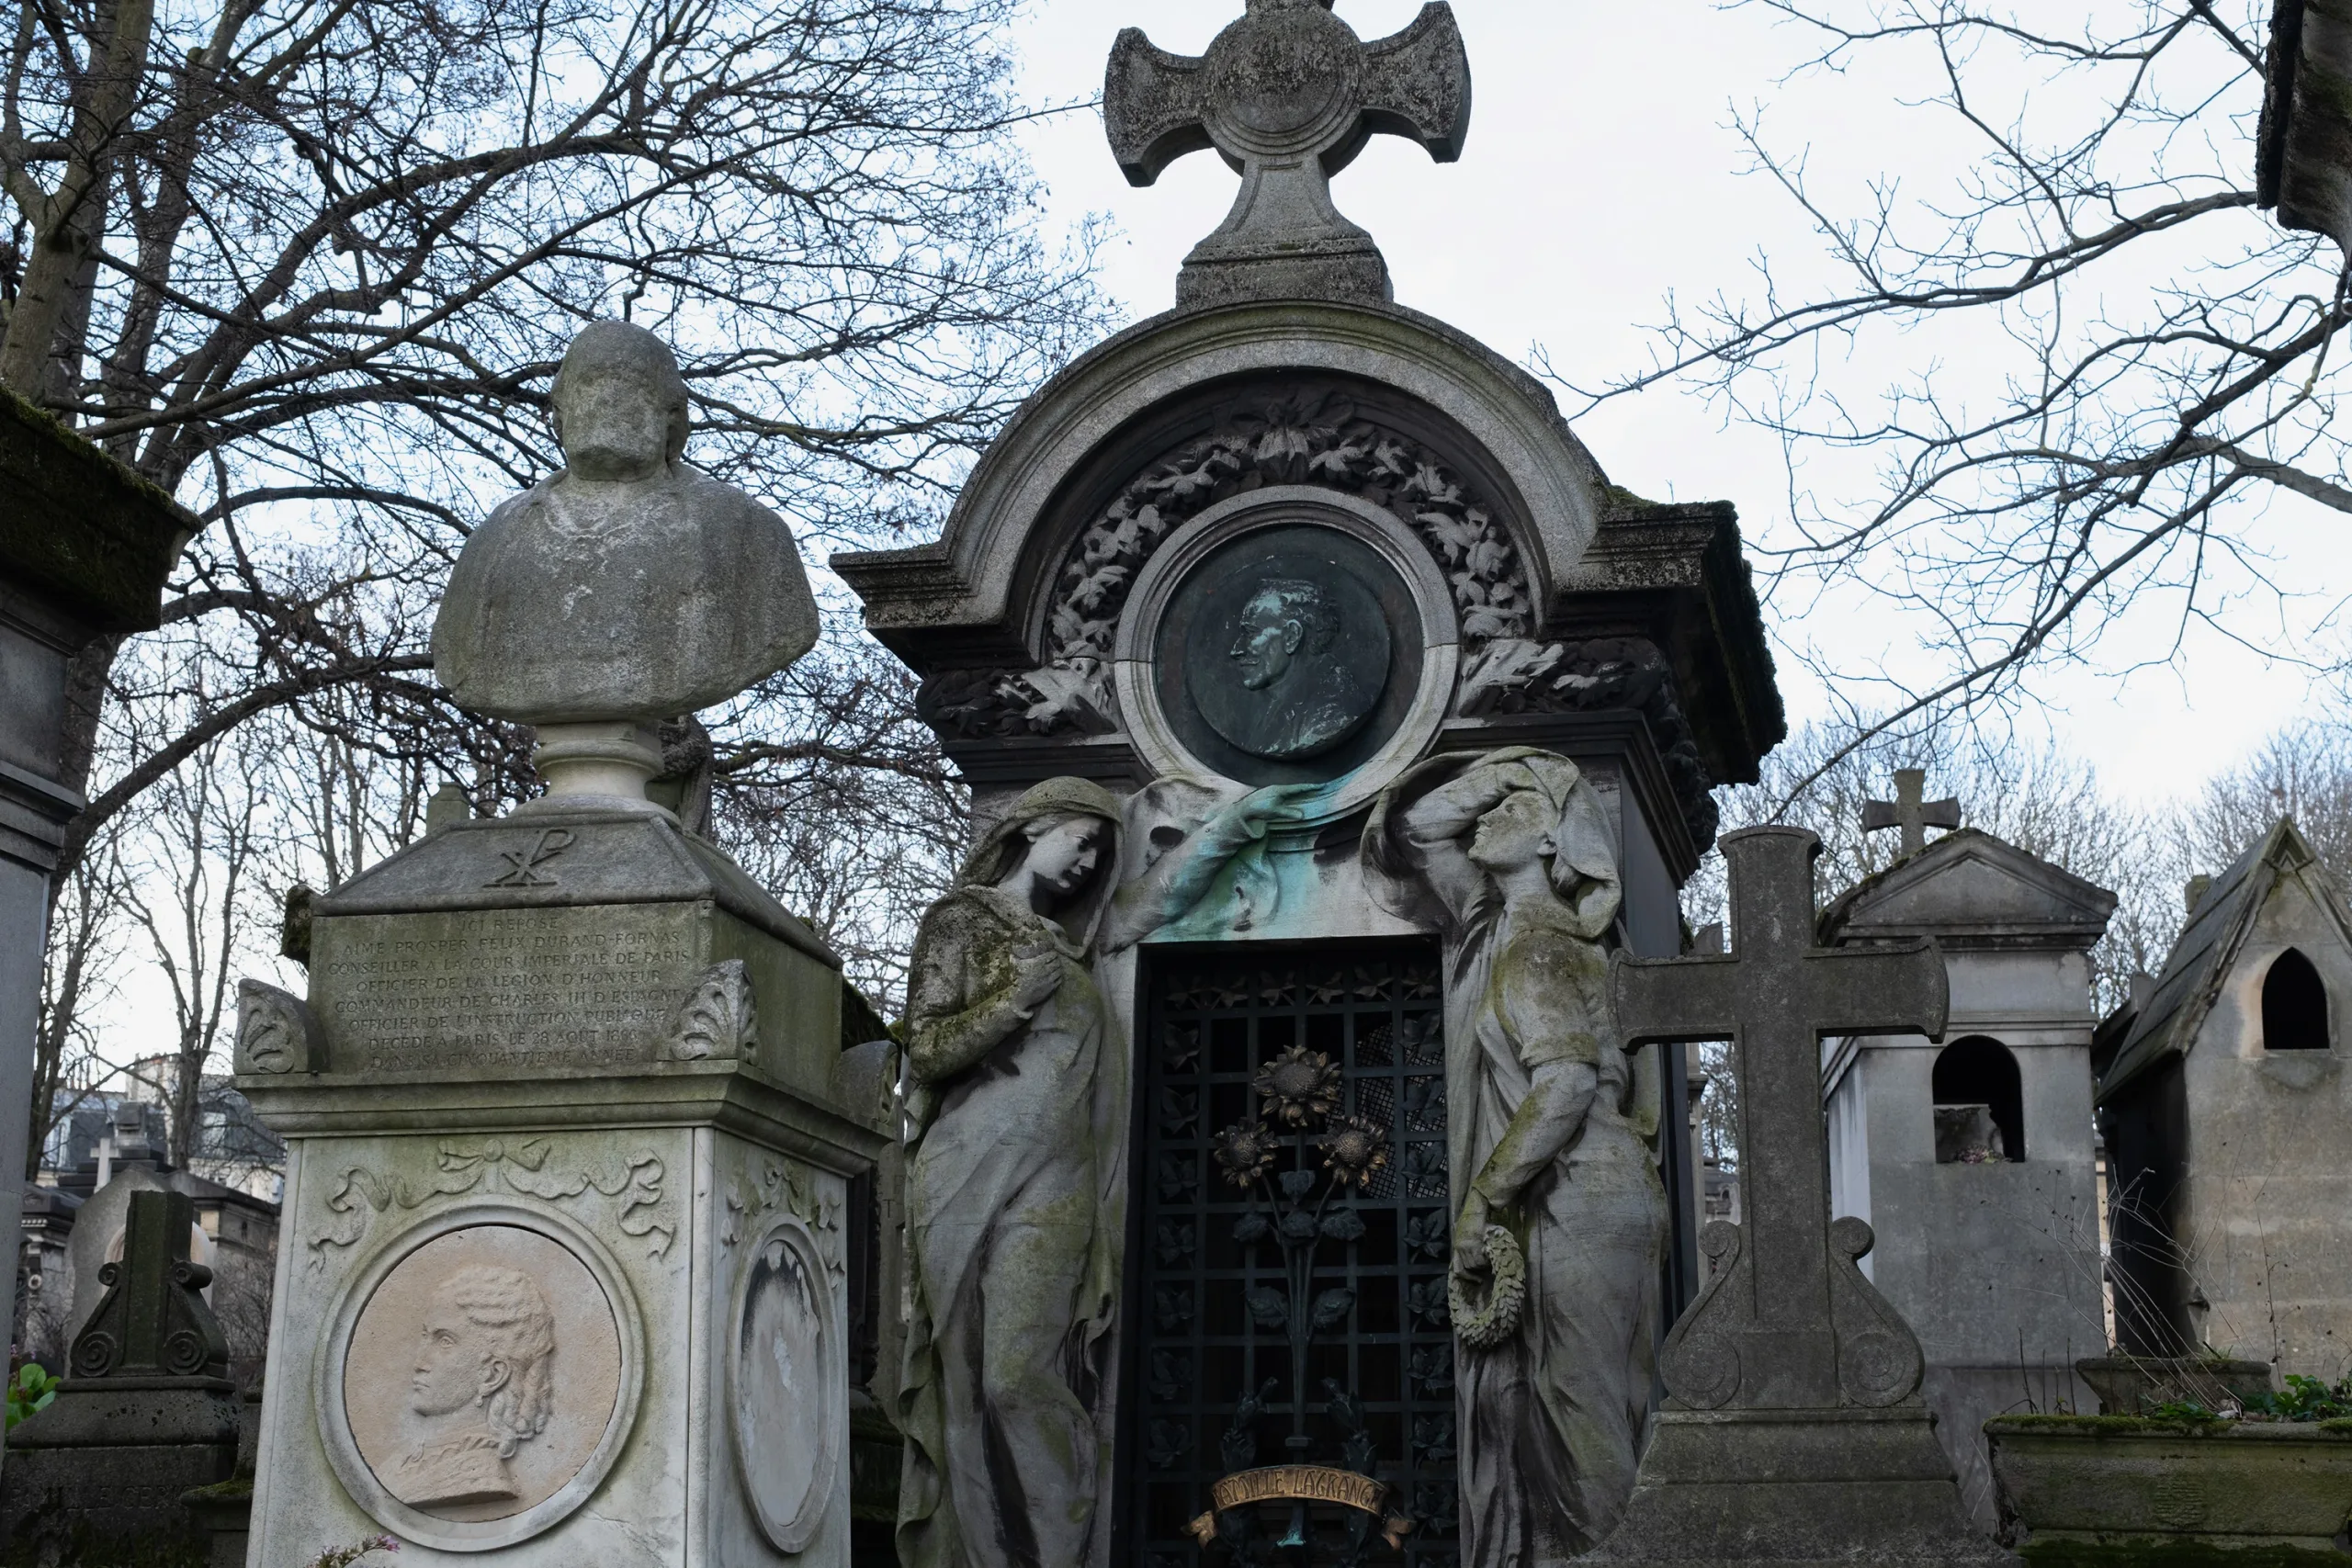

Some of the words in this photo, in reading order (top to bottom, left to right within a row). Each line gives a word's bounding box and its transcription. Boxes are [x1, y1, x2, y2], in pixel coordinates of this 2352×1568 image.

[462, 919, 485, 932] ICI
[494, 918, 559, 931] REPOSE
[395, 939, 469, 954] PROSPER
[328, 960, 419, 976] CONSEILLER
[444, 958, 462, 970] LA
[470, 956, 514, 970] COUR
[616, 952, 636, 964] DE
[644, 950, 690, 964] PARIS
[356, 978, 428, 993] OFFICIER
[435, 976, 458, 989] DE
[466, 976, 485, 988] LA
[334, 997, 453, 1014] COMMANDEUR
[459, 995, 481, 1009] DE
[489, 992, 559, 1007] CHARLES
[349, 1017, 419, 1032] OFFICIER
[427, 1015, 448, 1029] DE
[455, 1033, 499, 1049] PARIS
[509, 1032, 526, 1046] LE
[532, 1031, 549, 1044] 28
[1213, 1470, 1285, 1509] FAMILLE
[1293, 1470, 1384, 1512] LAGRANGE
